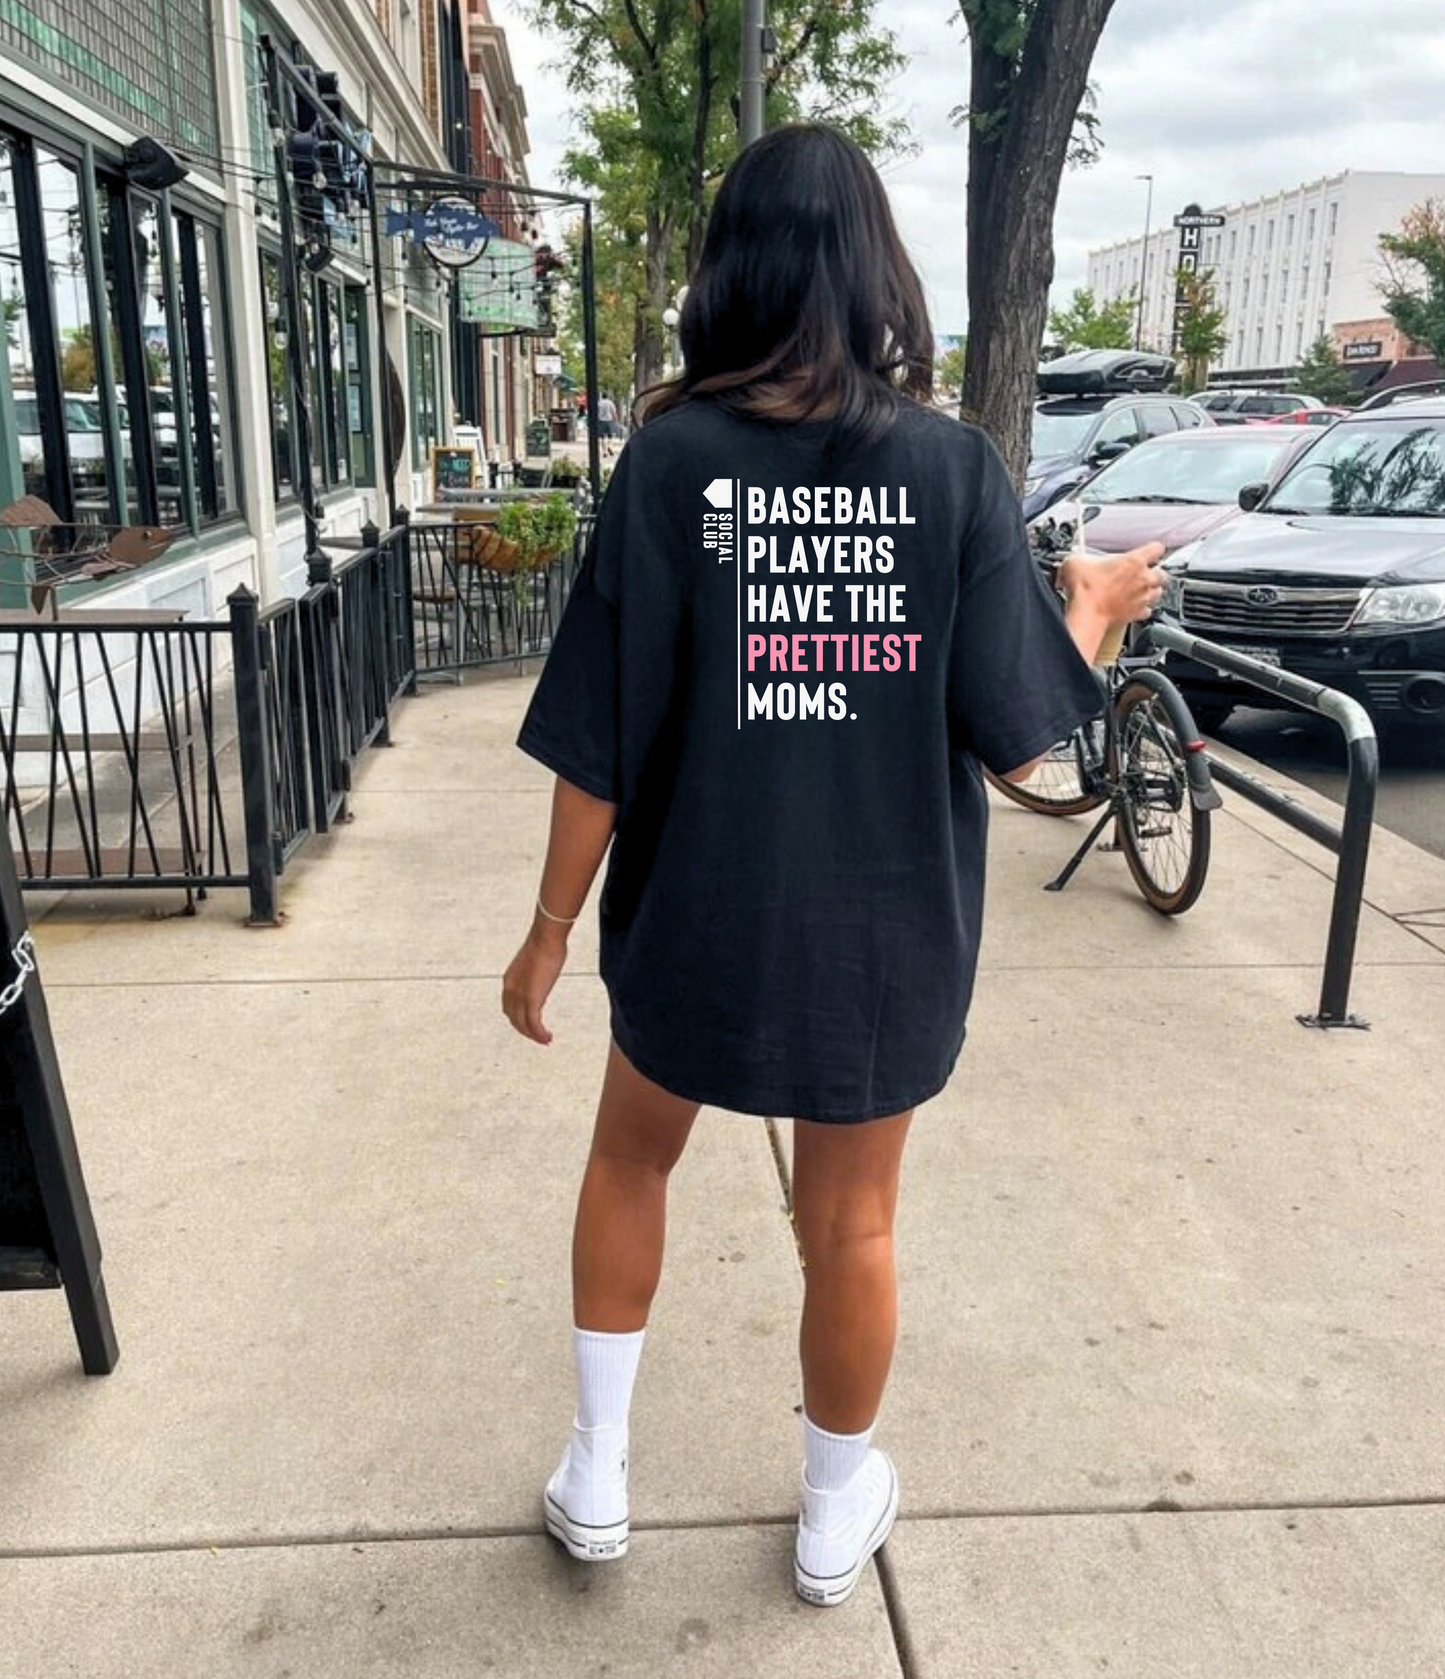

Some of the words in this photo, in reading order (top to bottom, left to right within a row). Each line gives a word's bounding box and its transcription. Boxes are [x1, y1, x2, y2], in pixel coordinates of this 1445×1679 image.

[1178, 217, 1221, 226] NORTHERN
[748, 487, 915, 524] BASEBALL
[703, 513, 717, 548] CLUB
[719, 513, 733, 564] SOCIAL
[748, 536, 894, 573] PLAYERS
[748, 585, 833, 622] HAVE
[845, 585, 906, 622] THE
[748, 634, 921, 671] PRETTIEST
[748, 682, 857, 720] MOMS.
